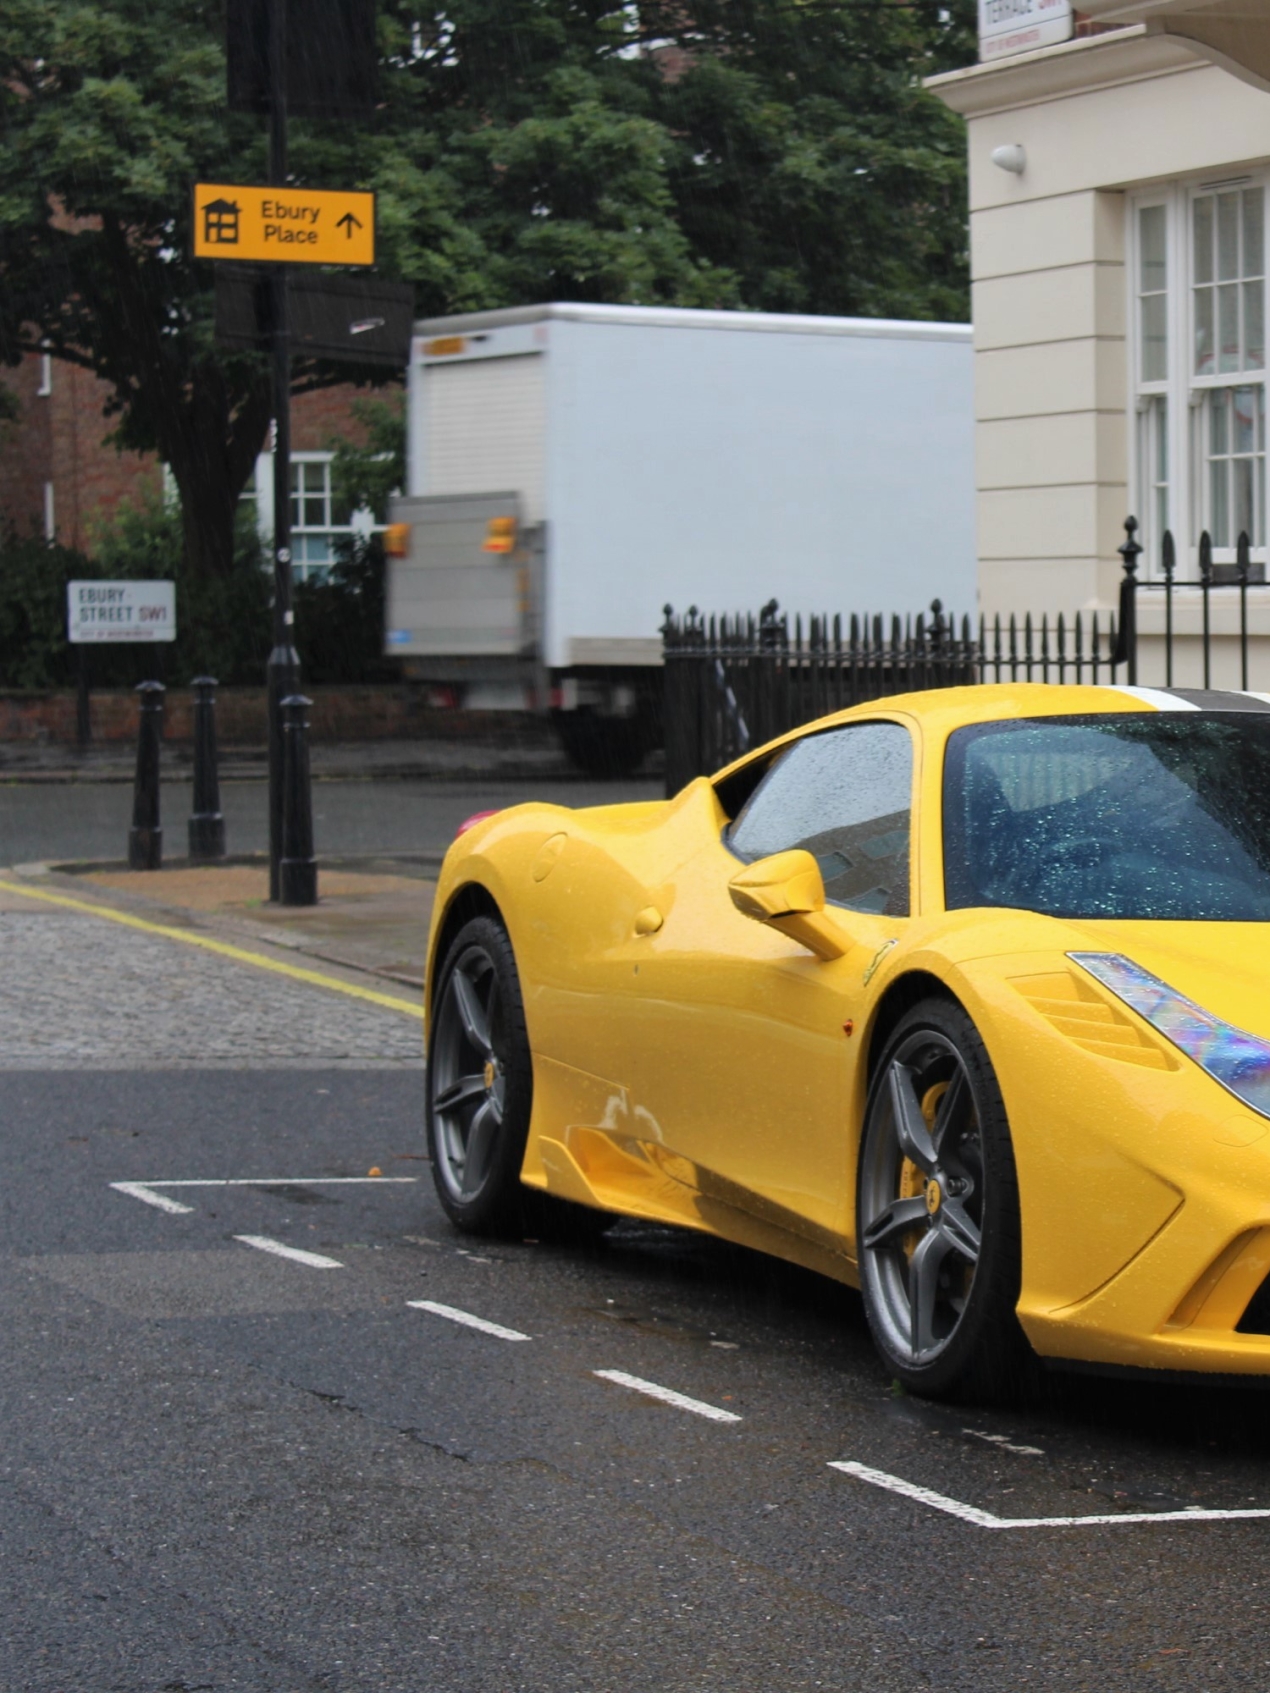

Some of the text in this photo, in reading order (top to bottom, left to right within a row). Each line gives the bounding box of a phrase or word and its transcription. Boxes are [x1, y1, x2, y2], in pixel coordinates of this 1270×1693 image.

[261, 200, 321, 224] Ebury
[264, 225, 318, 244] Place
[79, 588, 125, 604] EBURY
[80, 606, 167, 623] STREET SW1
